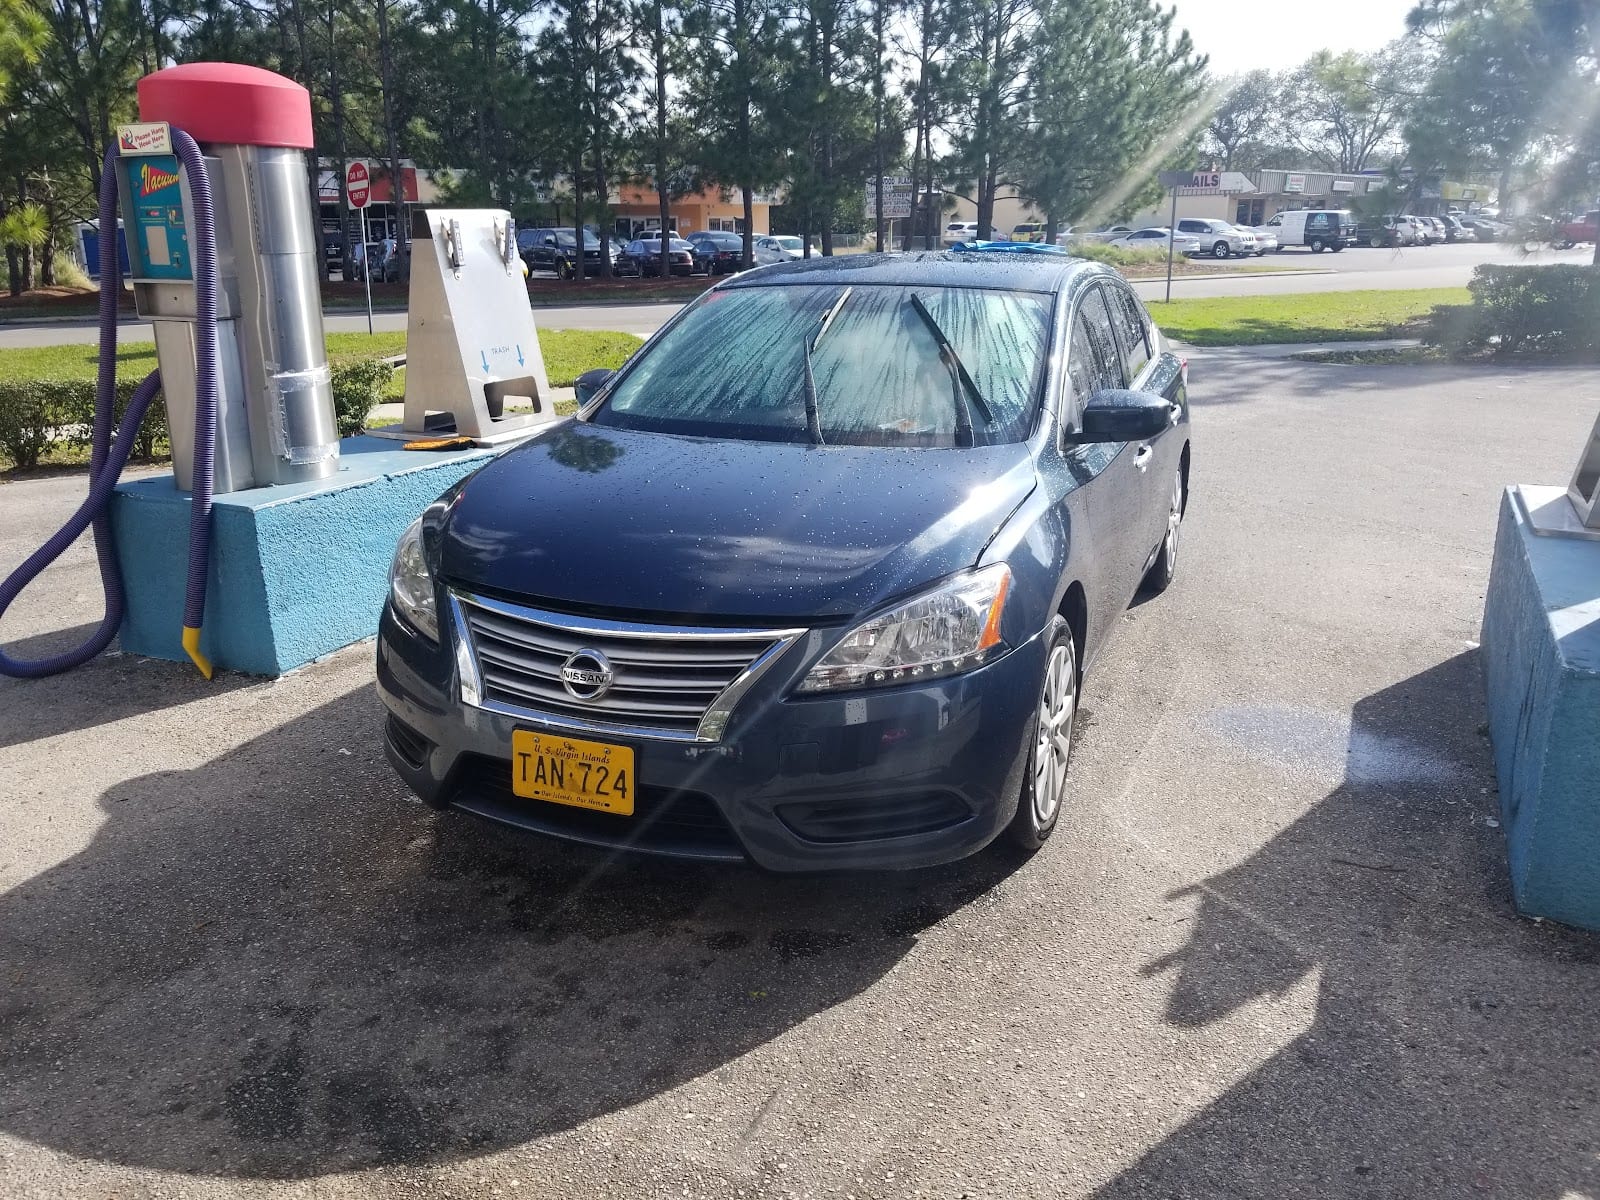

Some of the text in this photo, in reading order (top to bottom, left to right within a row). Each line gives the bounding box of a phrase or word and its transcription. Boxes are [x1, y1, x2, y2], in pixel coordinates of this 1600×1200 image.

[134, 126, 165, 143] Please Hang
[152, 135, 164, 143] Here
[141, 163, 179, 193] Vacuum
[350, 169, 365, 180] DO NOT
[1183, 175, 1219, 188] AILS
[353, 191, 365, 200] ENTER
[563, 670, 605, 683] NISSAN
[556, 748, 579, 760] Virgin
[581, 752, 611, 764] Islands
[518, 751, 627, 799] TAN 724
